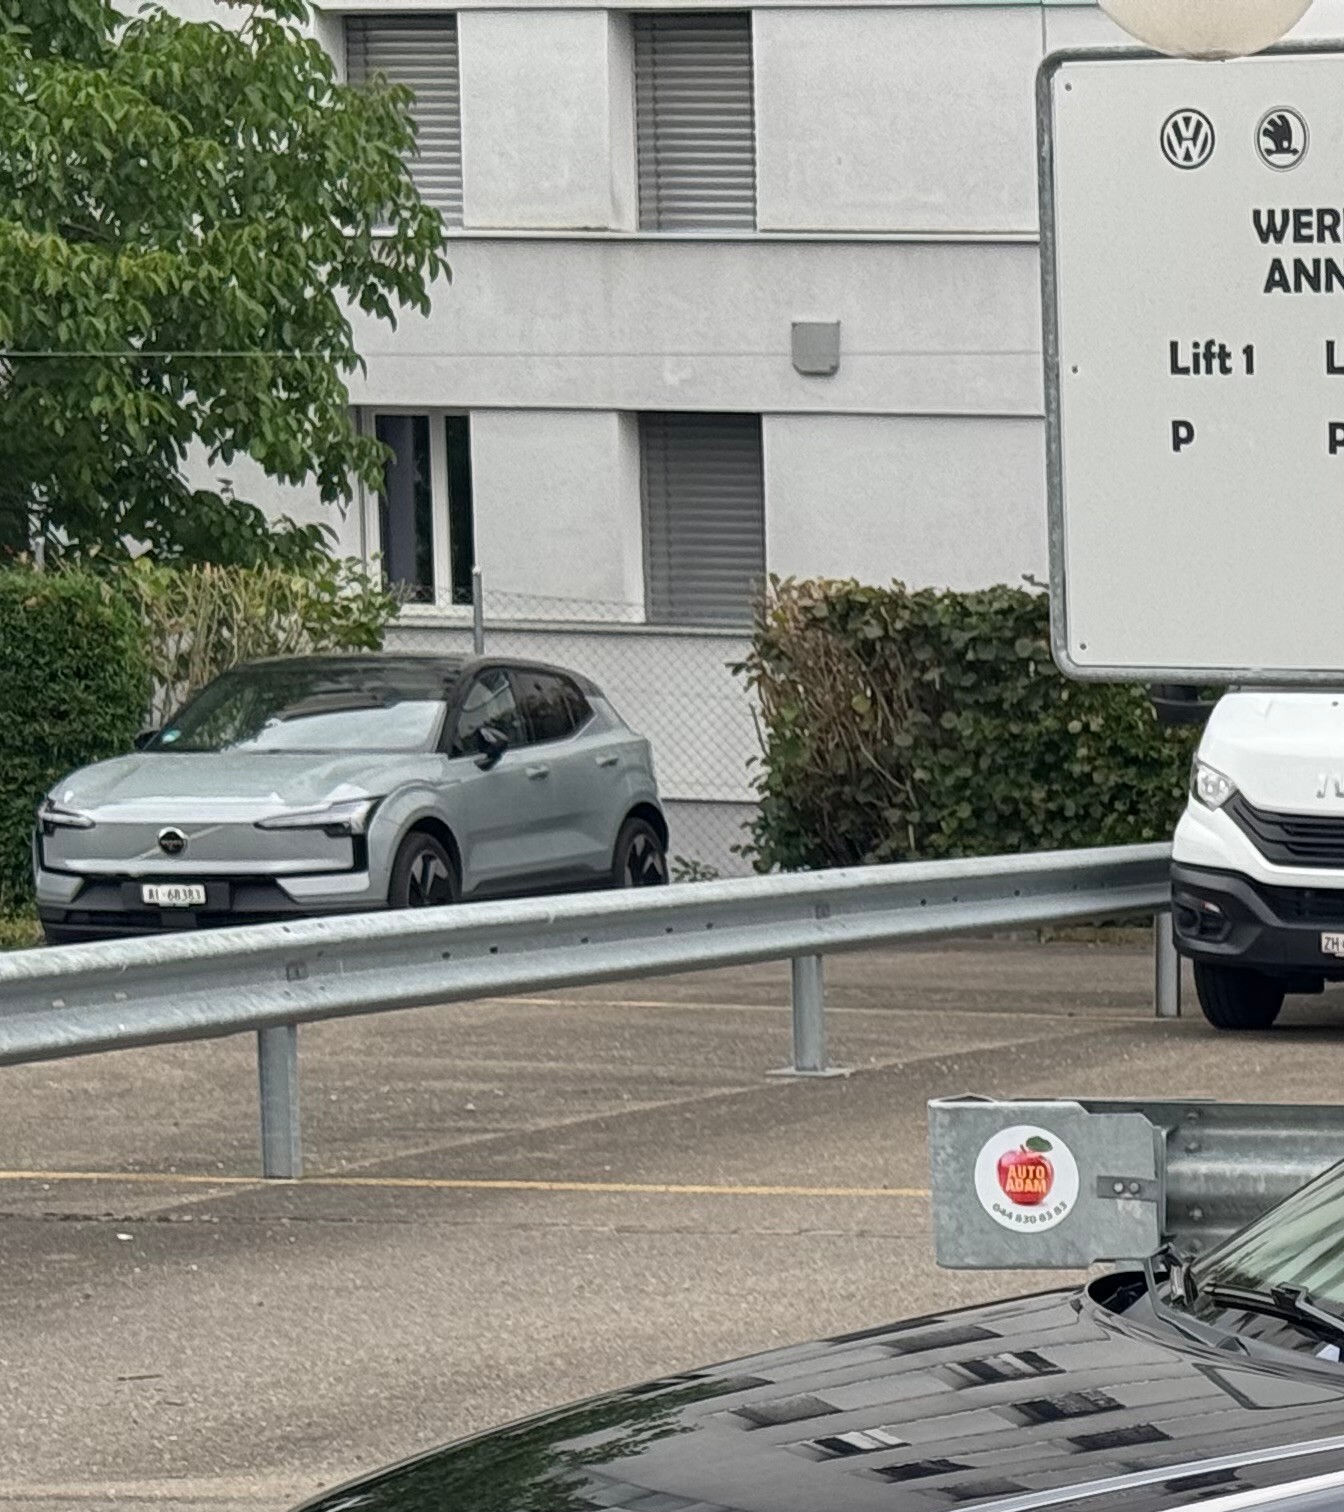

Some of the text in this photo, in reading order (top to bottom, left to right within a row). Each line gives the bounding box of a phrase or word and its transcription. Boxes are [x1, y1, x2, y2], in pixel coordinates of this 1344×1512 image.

[1169, 339, 1255, 376] Lift 1
[1171, 420, 1195, 452] P
[1325, 936, 1340, 952] ZH
[1007, 1165, 1046, 1179] AUTO
[1005, 1178, 1047, 1194] ADAM
